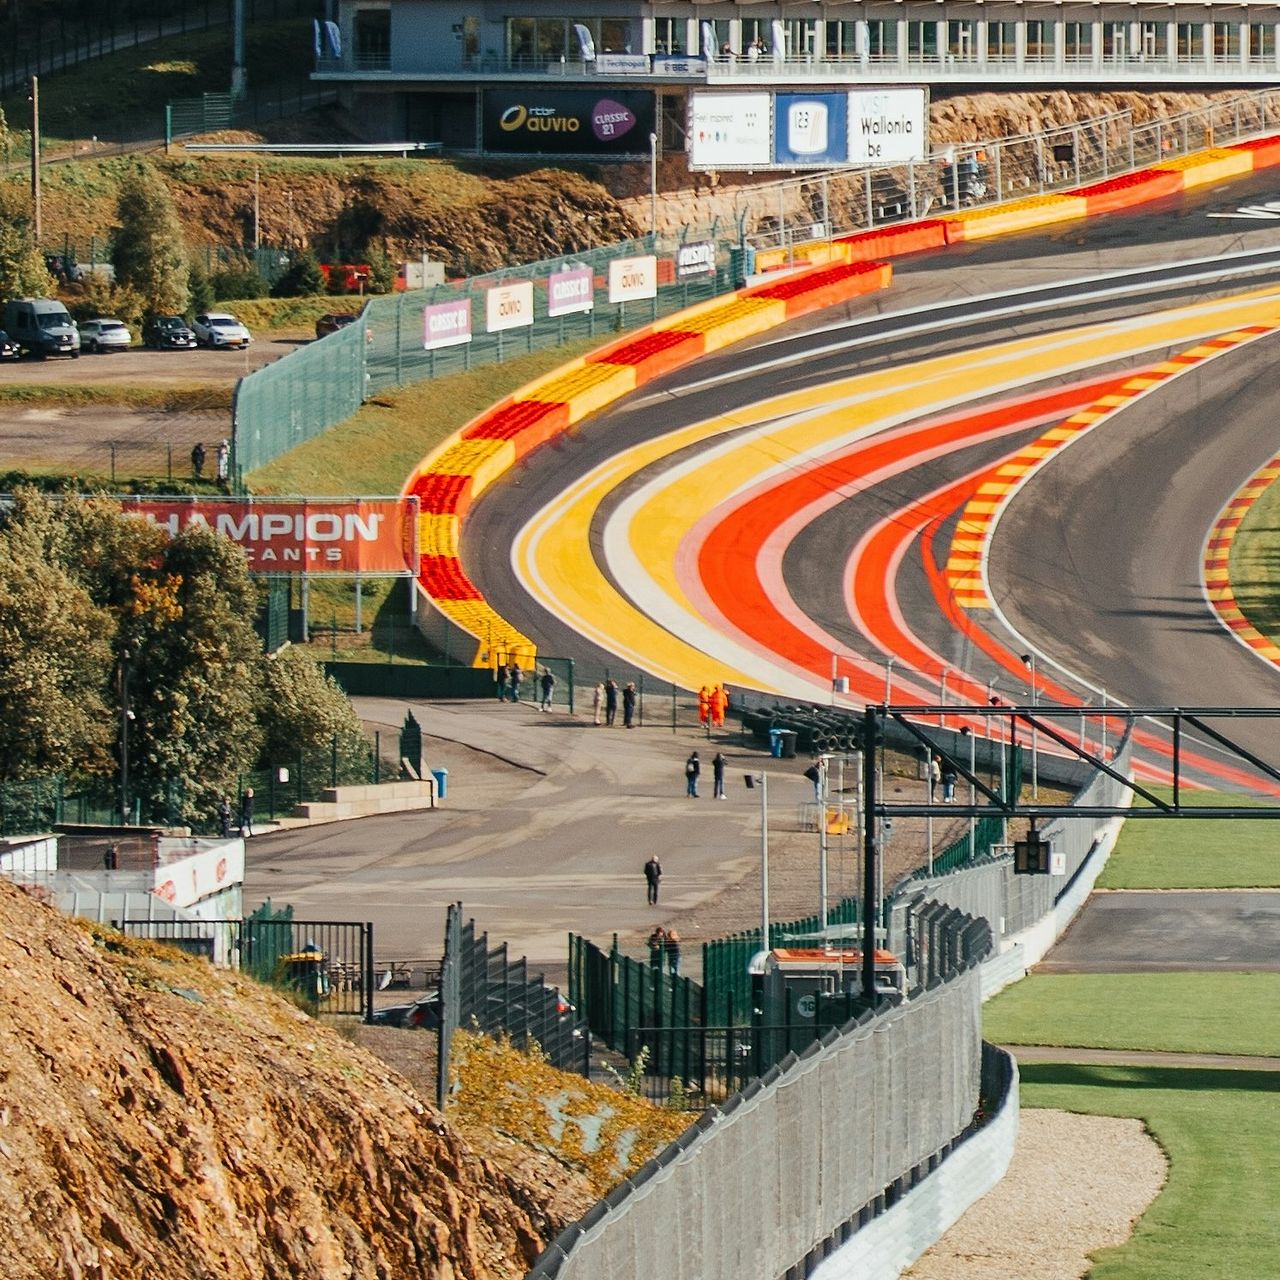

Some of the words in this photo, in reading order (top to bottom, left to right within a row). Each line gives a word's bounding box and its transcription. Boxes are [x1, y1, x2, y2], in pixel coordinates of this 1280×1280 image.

[595, 112, 629, 124] CLASSIC
[602, 124, 615, 135] 21
[862, 116, 913, 135] Wallonia
